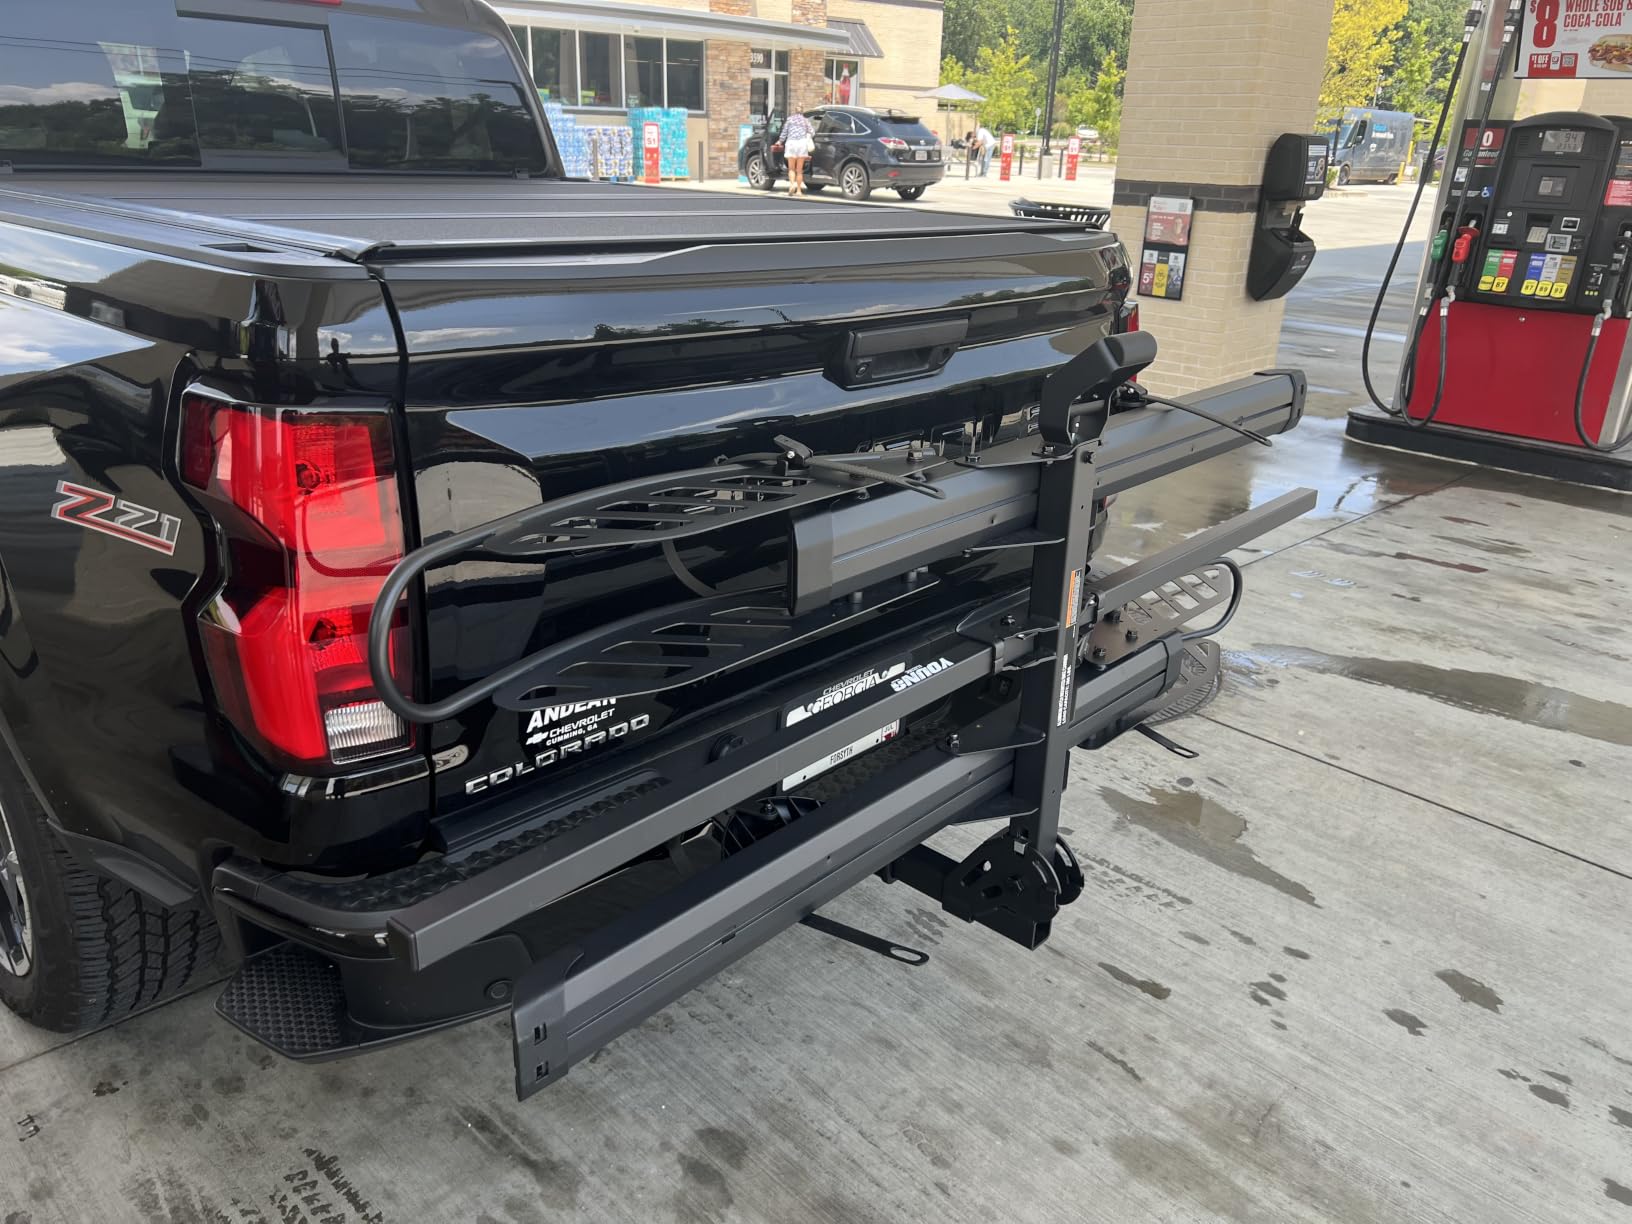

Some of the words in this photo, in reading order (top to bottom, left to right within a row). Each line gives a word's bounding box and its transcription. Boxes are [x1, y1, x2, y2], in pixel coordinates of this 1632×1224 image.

[1565, 0, 1599, 12] WHOLE
[1602, 0, 1624, 11] SUB
[811, 673, 880, 714] GEORGIA
[823, 668, 875, 695] CHEVROLET
[546, 729, 586, 746] CUMMING,
[587, 723, 598, 731] GA
[549, 708, 616, 738] CHEVROLET
[464, 713, 650, 795] COLORADO
[830, 746, 854, 766] FORSYTH
